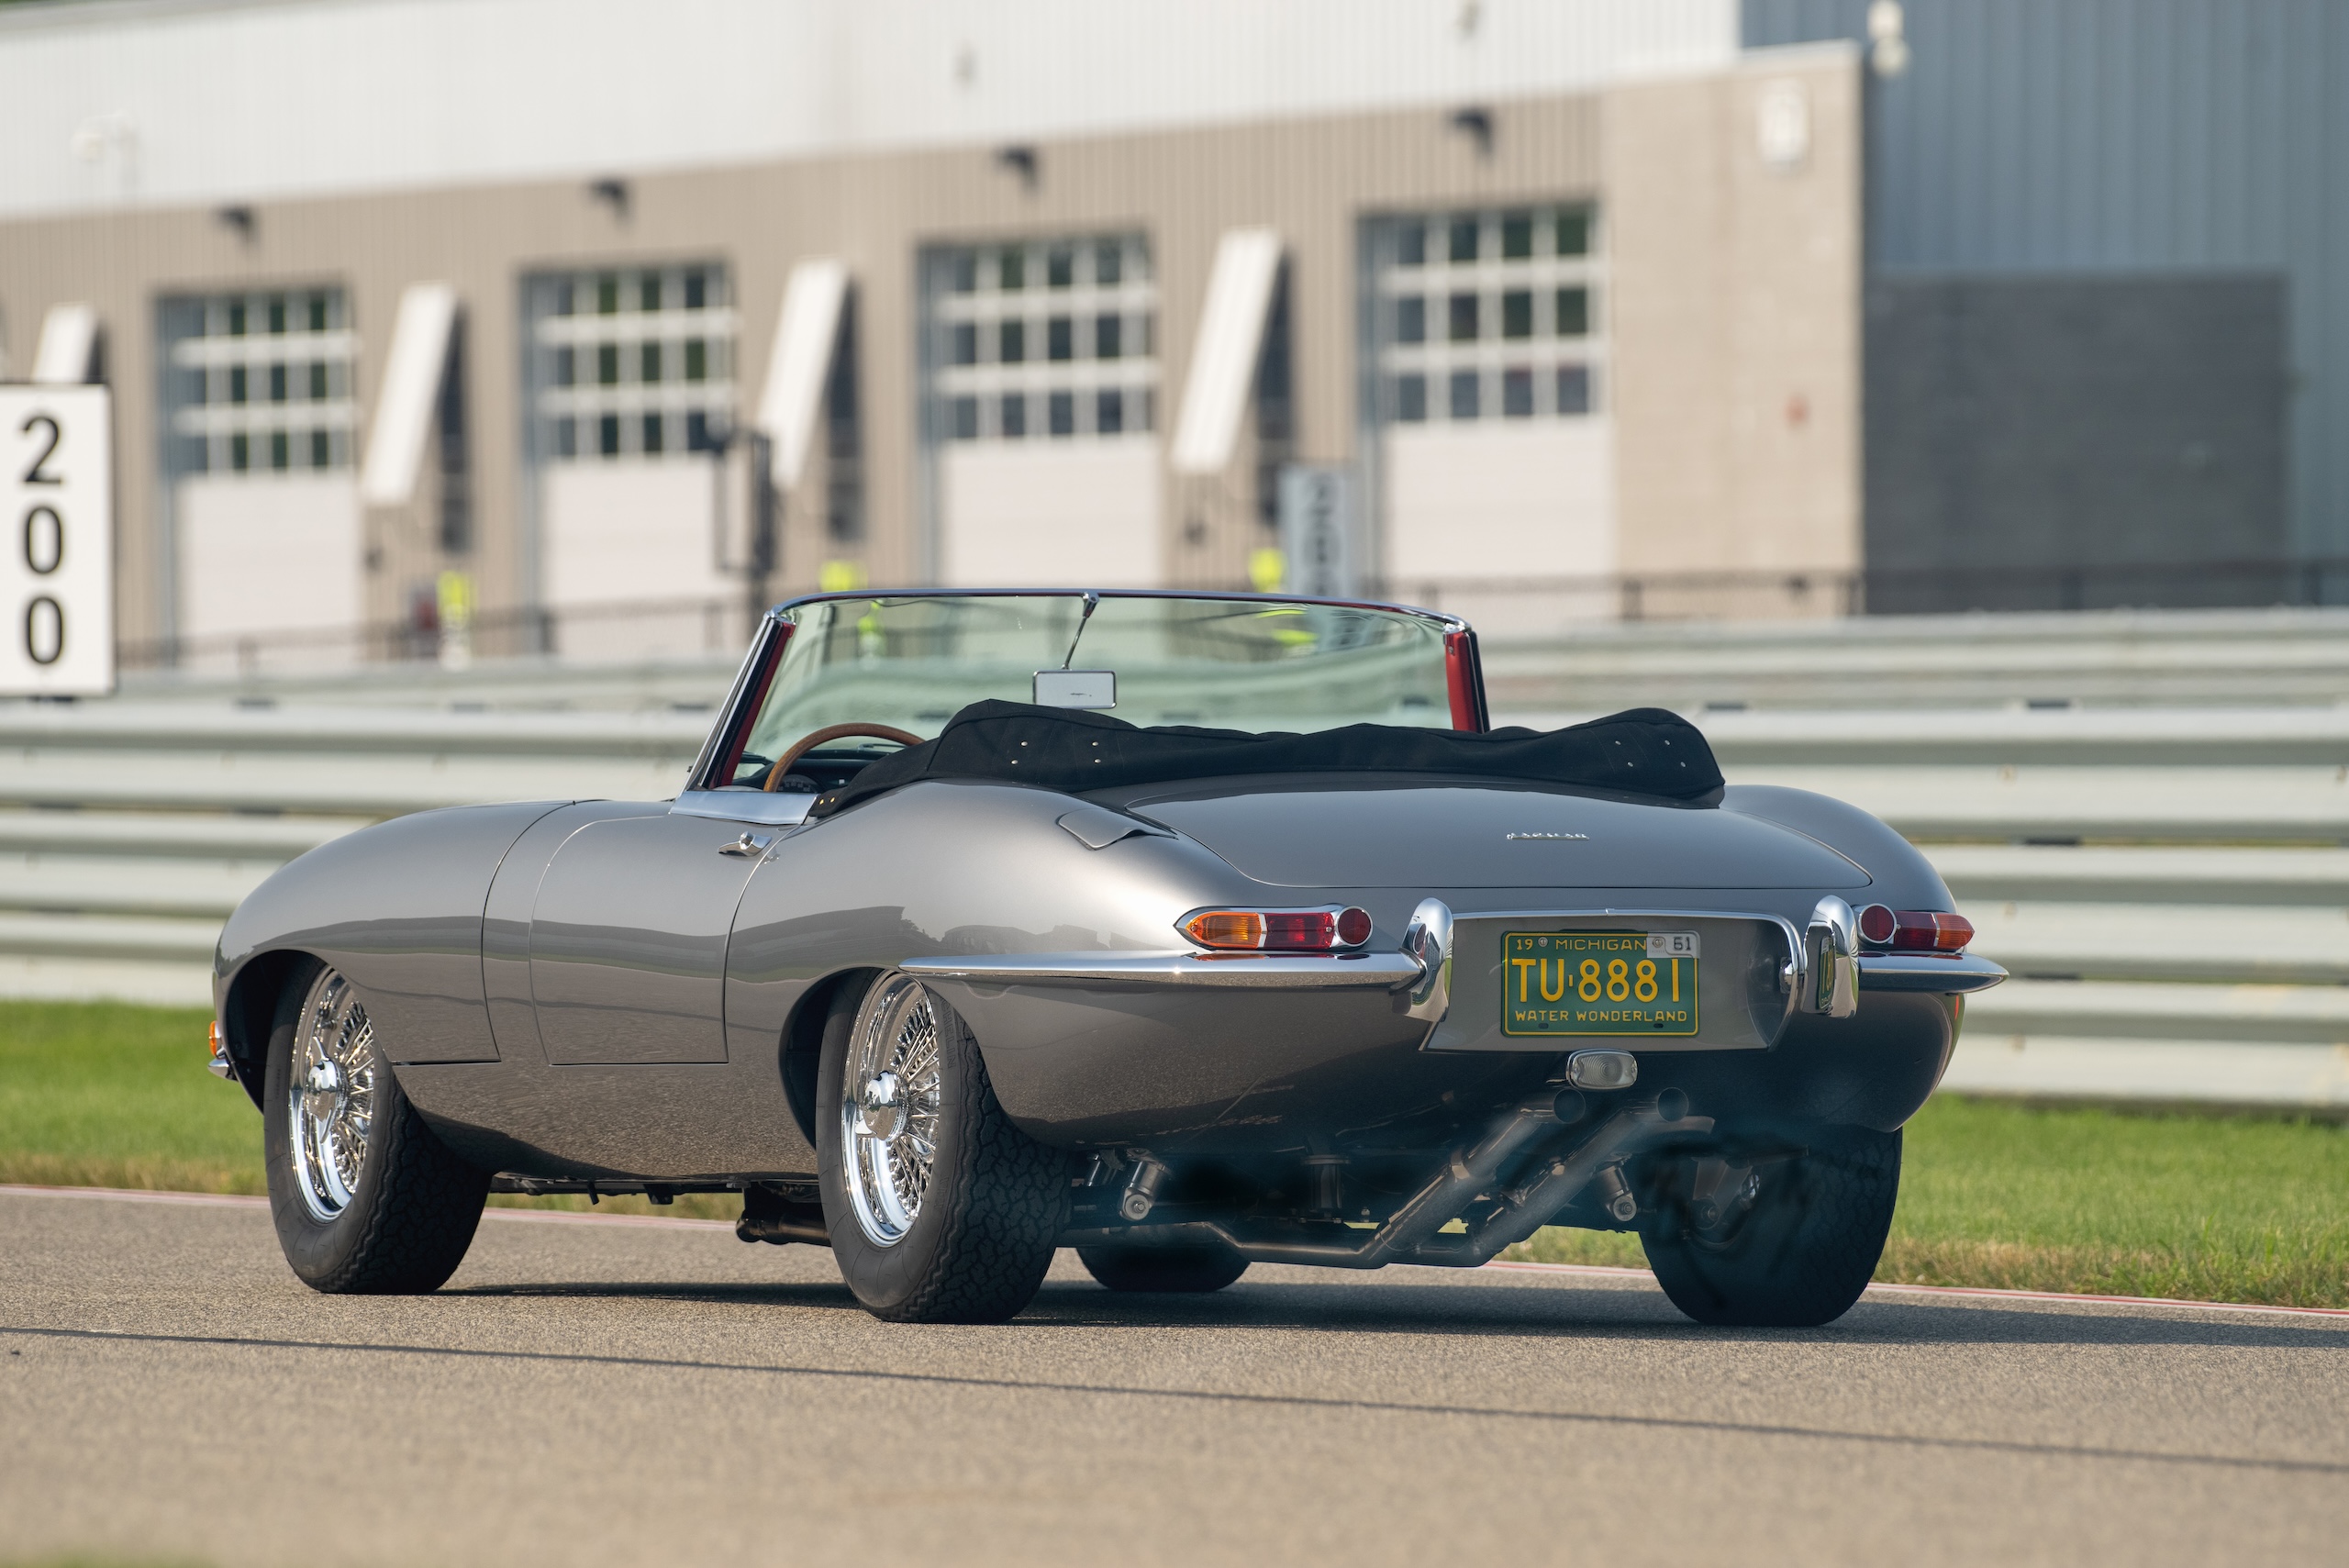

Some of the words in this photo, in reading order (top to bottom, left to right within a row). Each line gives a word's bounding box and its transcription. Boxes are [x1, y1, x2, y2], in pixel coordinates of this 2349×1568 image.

[21, 415, 64, 665] 200
[1516, 939, 1533, 951] 19
[1555, 939, 1647, 951] MICHIGAN
[1673, 937, 1691, 951] 61
[1515, 1010, 1569, 1022] WATER
[1575, 1010, 1687, 1022] WONDERLAND
[941, 997, 957, 1069] CHELIN
